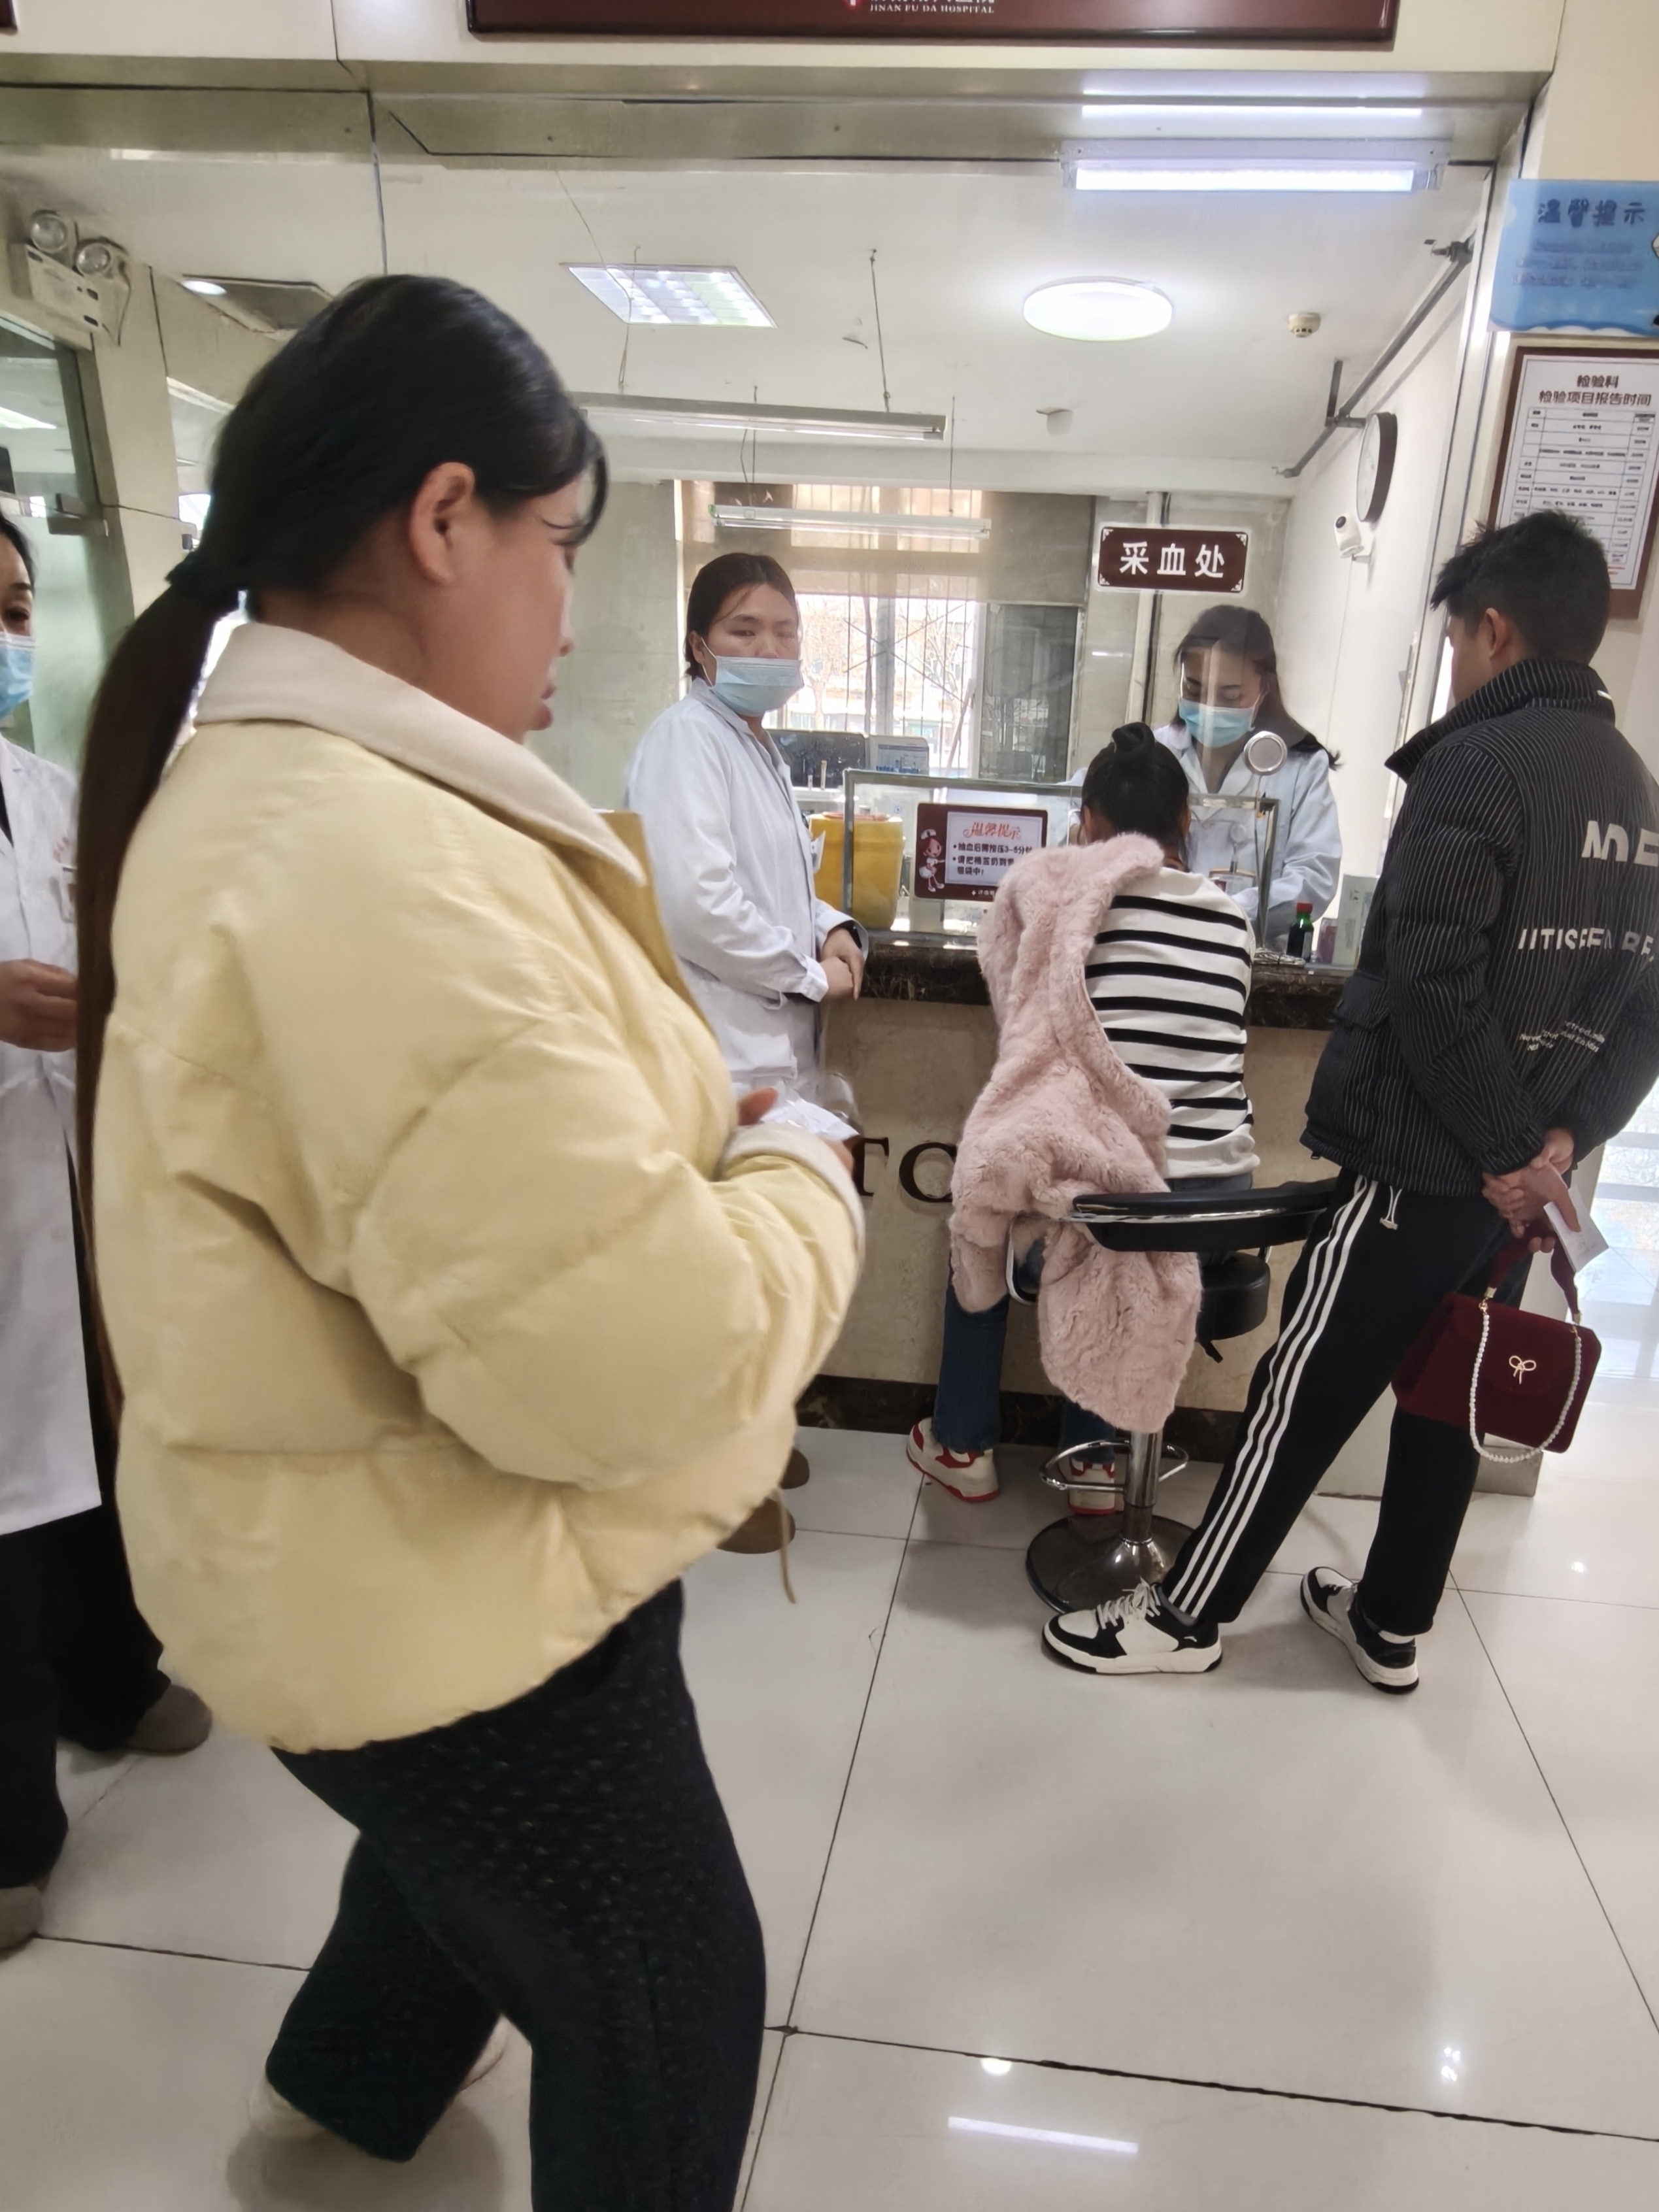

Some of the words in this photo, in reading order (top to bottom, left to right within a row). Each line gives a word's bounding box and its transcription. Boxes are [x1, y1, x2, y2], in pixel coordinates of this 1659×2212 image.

[941, 5, 994, 14] HOSPITAL
[1576, 374, 1619, 388] 检验科
[1539, 390, 1652, 407] 检验项目报告时间
[1119, 541, 1225, 578] 采血处
